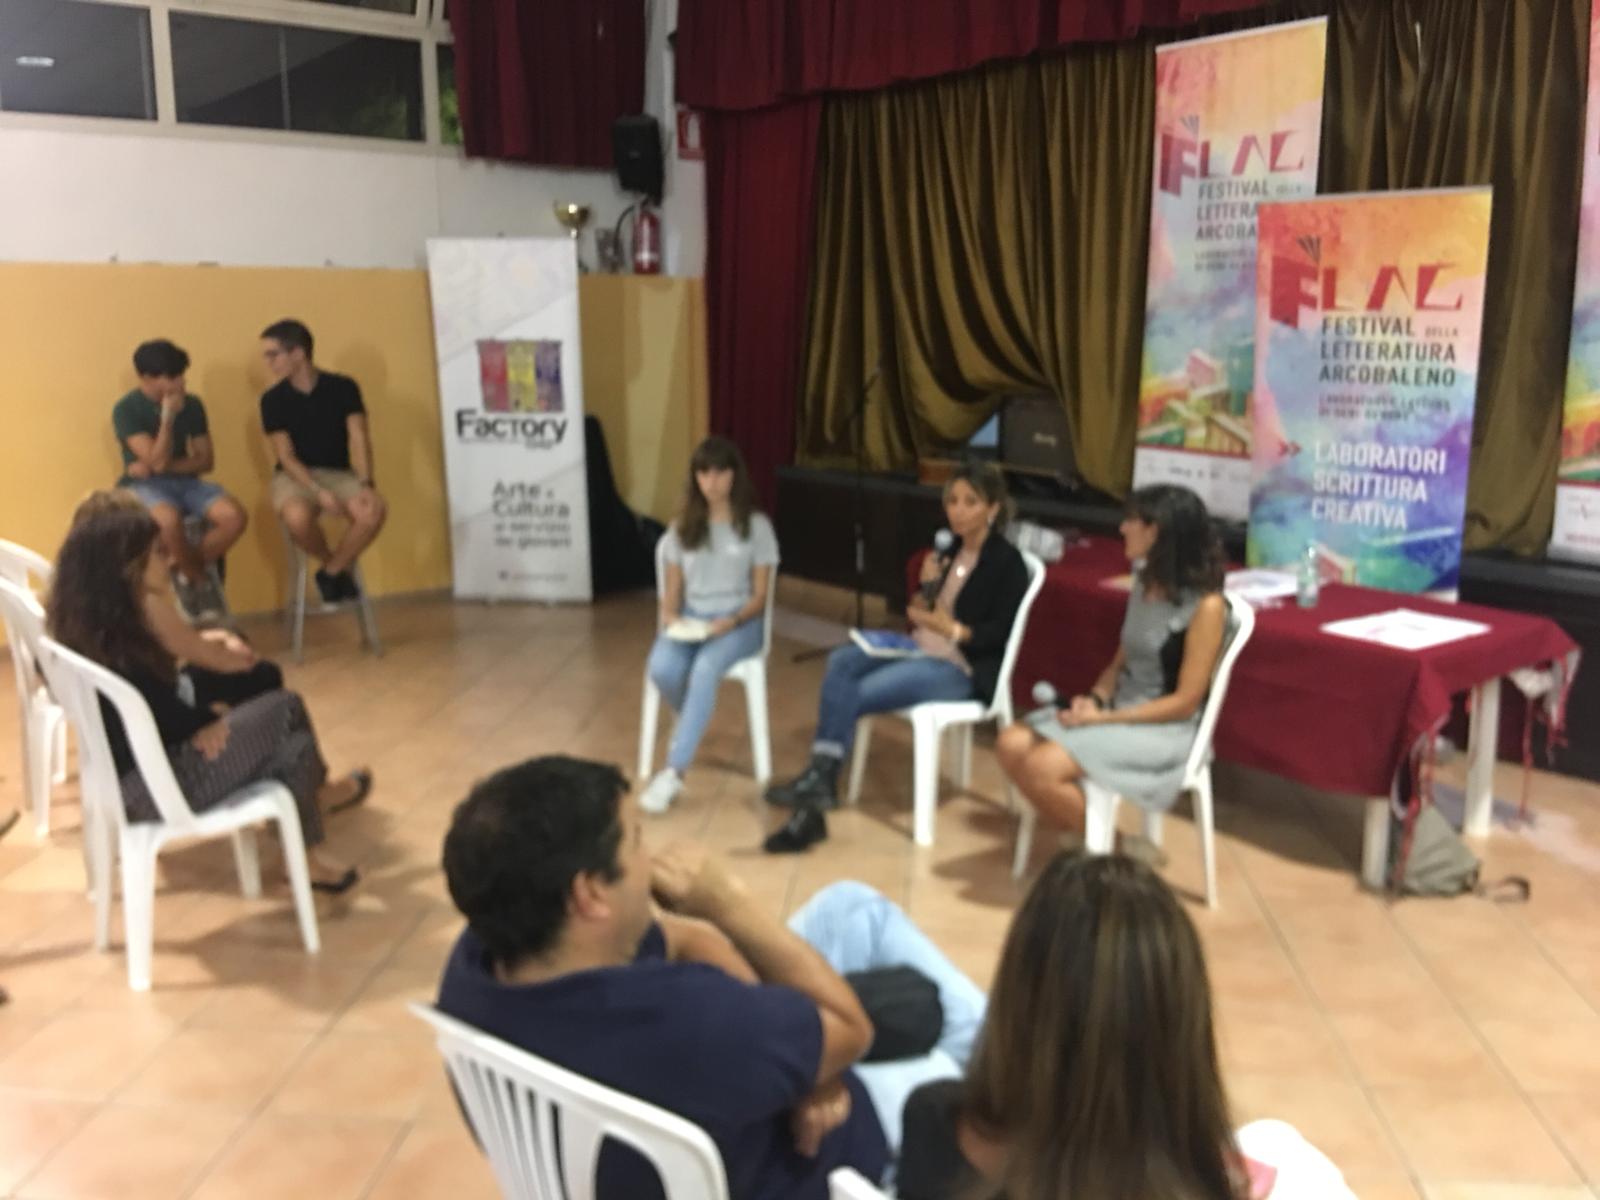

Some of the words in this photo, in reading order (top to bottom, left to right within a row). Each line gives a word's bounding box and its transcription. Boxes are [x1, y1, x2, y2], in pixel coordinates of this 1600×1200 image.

[1199, 180, 1268, 199] FESTIVAL
[1196, 202, 1257, 220] LETTERA
[1195, 223, 1257, 241] ARCOBA
[1322, 317, 1415, 337] FESTIVAL
[1321, 341, 1456, 362] LETTERATURA
[1319, 365, 1456, 387] ARCOBALENO
[456, 409, 567, 443] Factory
[1315, 442, 1446, 475] LABORATORI
[493, 480, 541, 499] Arte
[1313, 468, 1427, 503] SCRITTURA
[493, 499, 570, 518] Cultura
[1312, 498, 1407, 529] CREATIVA
